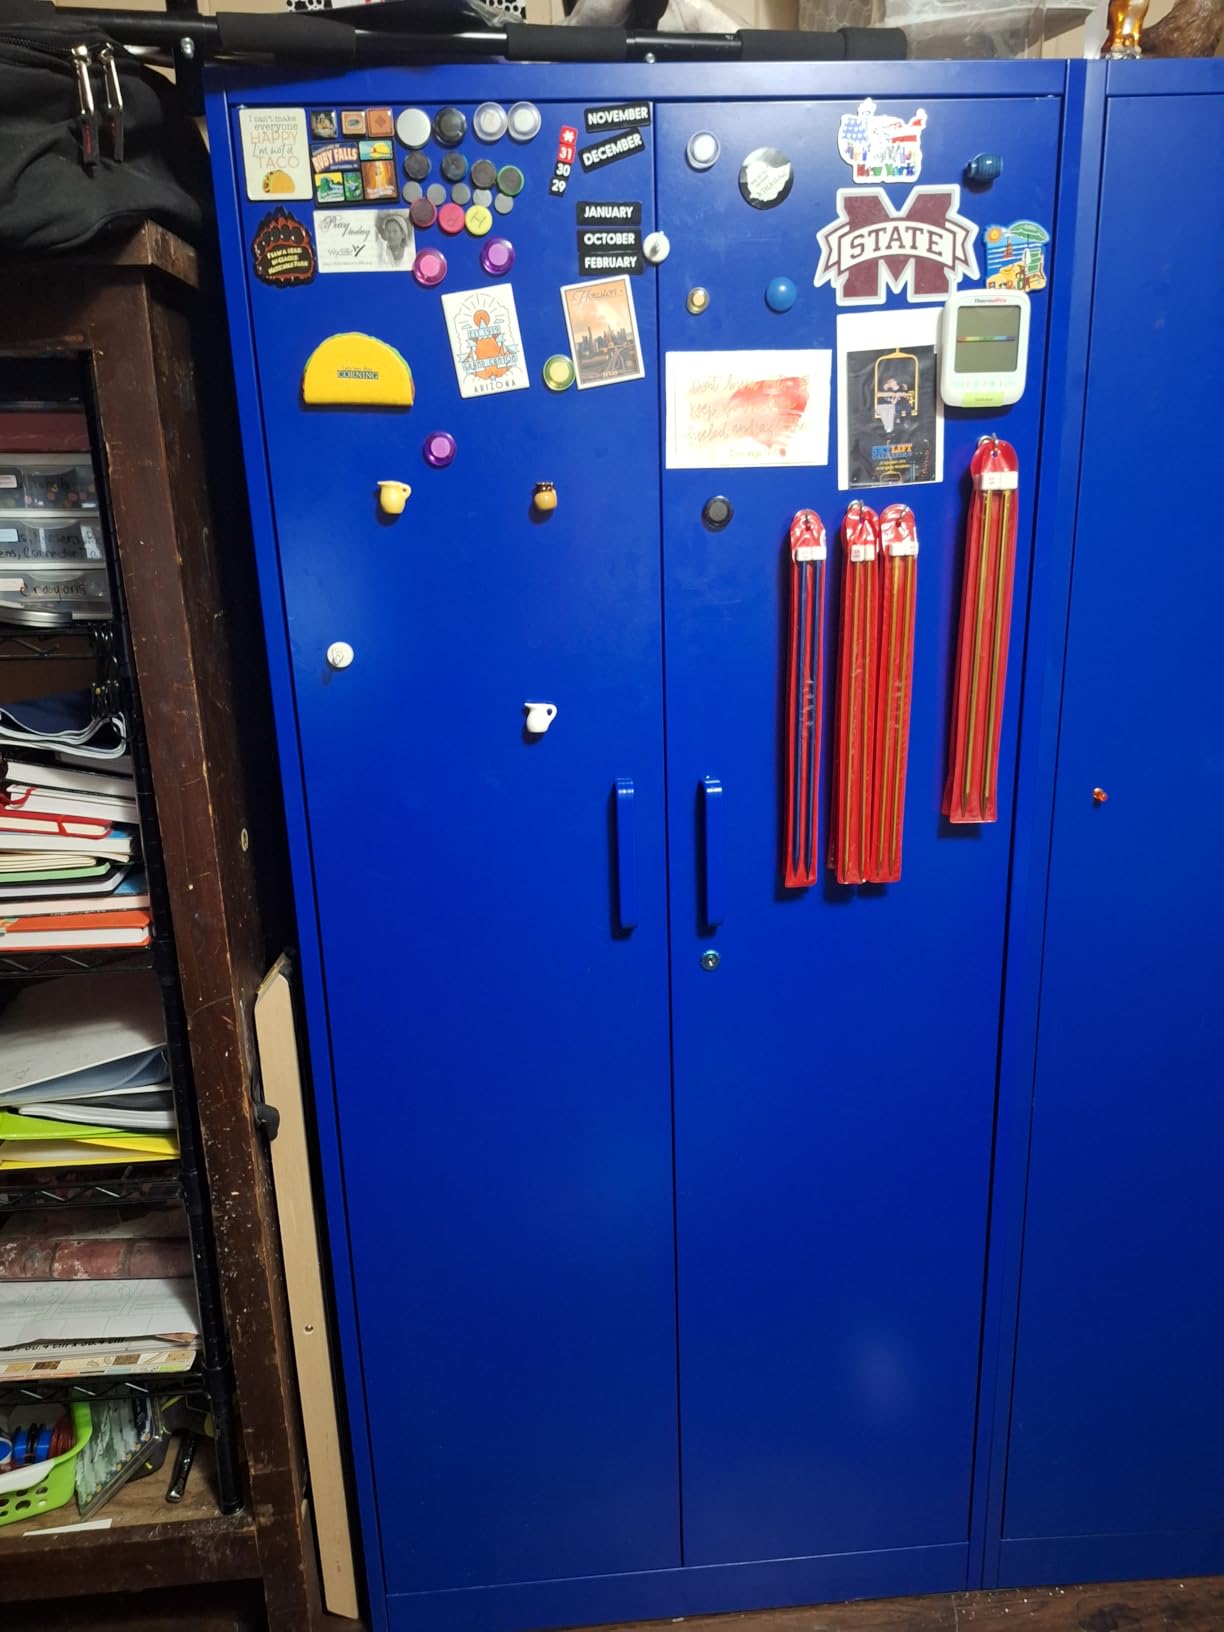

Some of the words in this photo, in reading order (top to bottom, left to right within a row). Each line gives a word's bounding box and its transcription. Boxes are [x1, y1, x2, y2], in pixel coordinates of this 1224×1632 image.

[587, 106, 649, 125] NOVEMBER
[254, 123, 298, 132] everyone
[250, 131, 298, 144] HAPPY
[559, 147, 572, 160] 31
[582, 133, 643, 167] DECEMBER
[256, 156, 300, 169] TACO
[311, 150, 333, 173] RUBY
[333, 148, 358, 162] FALLS
[556, 163, 571, 177] 30
[857, 164, 882, 177] New
[885, 163, 915, 177] York
[551, 178, 566, 193] 29
[584, 206, 634, 218] JANUARY
[320, 215, 350, 237] Pray
[583, 232, 635, 245] OCTOBER
[850, 225, 943, 260] STATE
[584, 256, 638, 269] FEBRUARY
[337, 370, 379, 380] CORNING
[474, 379, 516, 393] ARIZONA
[20, 582, 87, 600] Crayons
